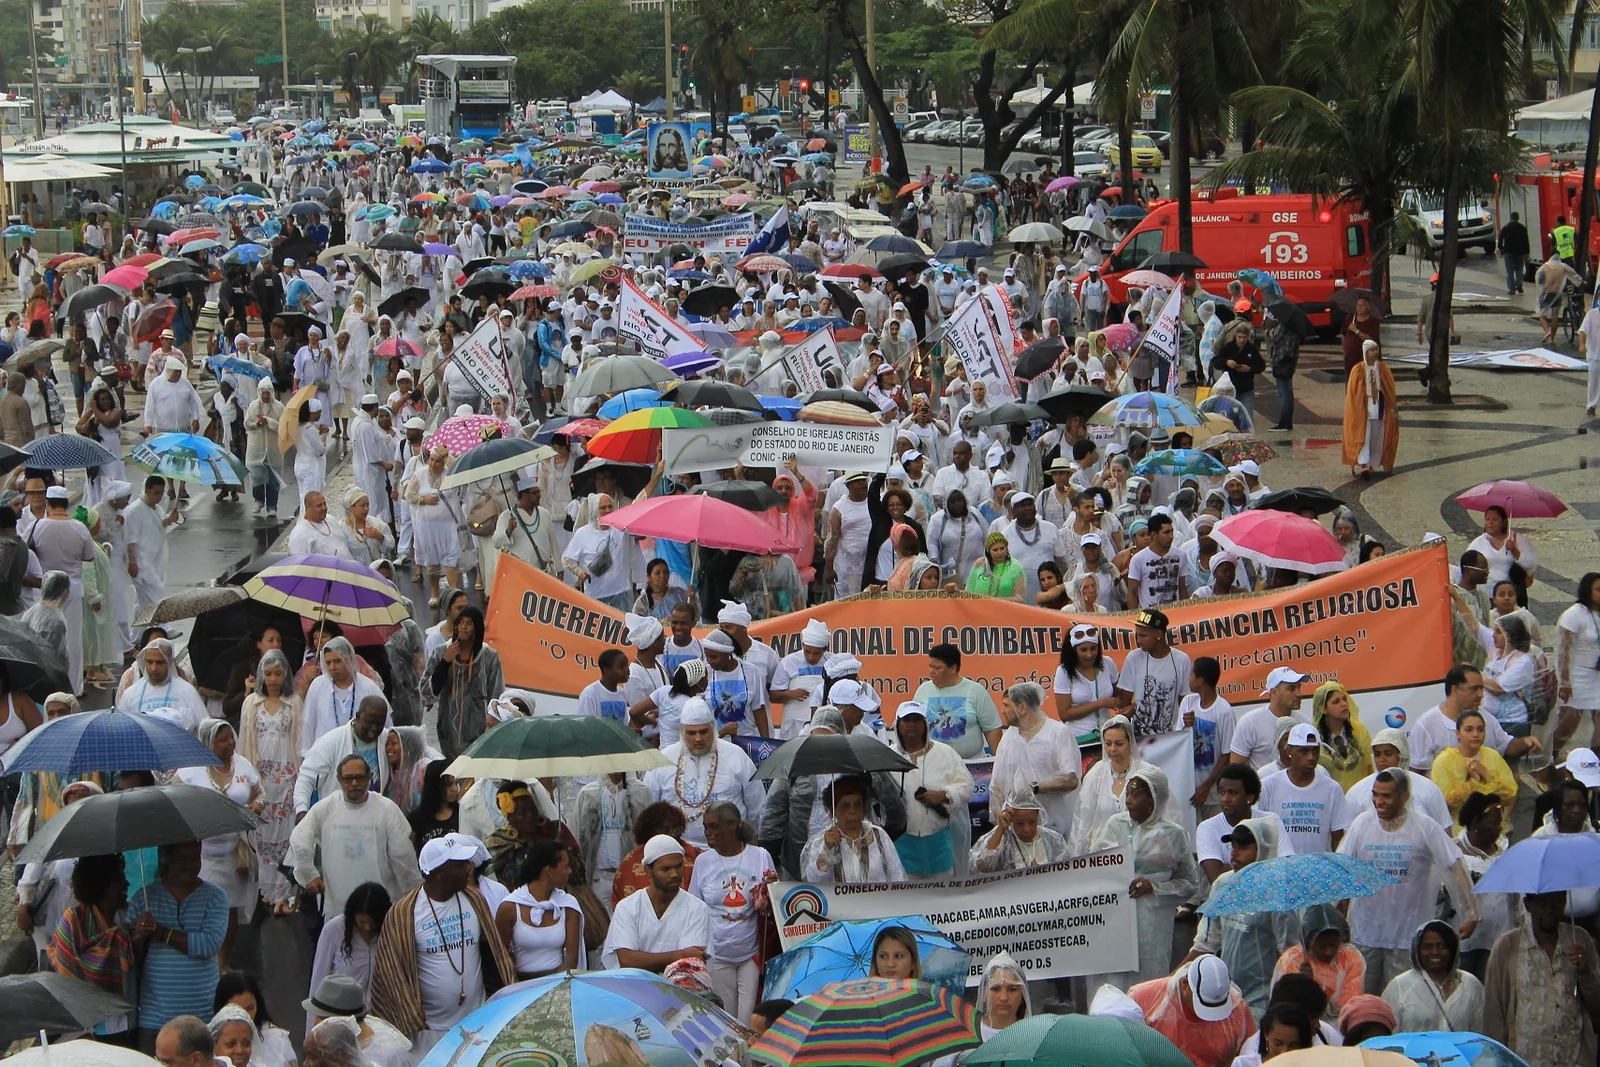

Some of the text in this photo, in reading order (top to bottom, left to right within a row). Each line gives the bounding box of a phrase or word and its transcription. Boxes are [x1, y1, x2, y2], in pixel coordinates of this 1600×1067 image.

[1191, 215, 1230, 223] BULÂNCIA
[1272, 212, 1298, 223] GSE
[625, 239, 648, 248] EU
[1260, 244, 1309, 264] 193
[1263, 271, 1322, 280] OMBEIROS
[624, 320, 640, 332] RIO
[1151, 330, 1168, 343] RIO
[951, 331, 964, 348] RIO
[961, 349, 972, 366] DE
[460, 350, 476, 368] RIO
[476, 368, 490, 383] DE
[790, 354, 802, 374] RIO
[752, 427, 880, 442] CONSELHO DE IGREJAS CRISTÃS
[751, 440, 875, 454] DO ESTADO DO RIO DE JANEIRO
[750, 452, 775, 462] CONIC
[520, 590, 632, 647] QUEREM
[770, 626, 897, 658] NAONAL
[903, 626, 935, 657] DE
[1284, 576, 1420, 630] RELIGIOSA
[575, 653, 600, 671] qu
[1014, 670, 1055, 690] afe
[1216, 679, 1246, 696] artin
[1282, 802, 1324, 810] CAMINHANDO
[1292, 818, 1320, 826] ENTENDE
[834, 854, 1124, 895] CONSELHO MUNICIPAL DE DEFESA DOS DIREITOS DO NEGRO
[422, 912, 470, 931] CAMINHANDO
[440, 940, 463, 953] TENHO
[1036, 956, 1052, 970] D.S
